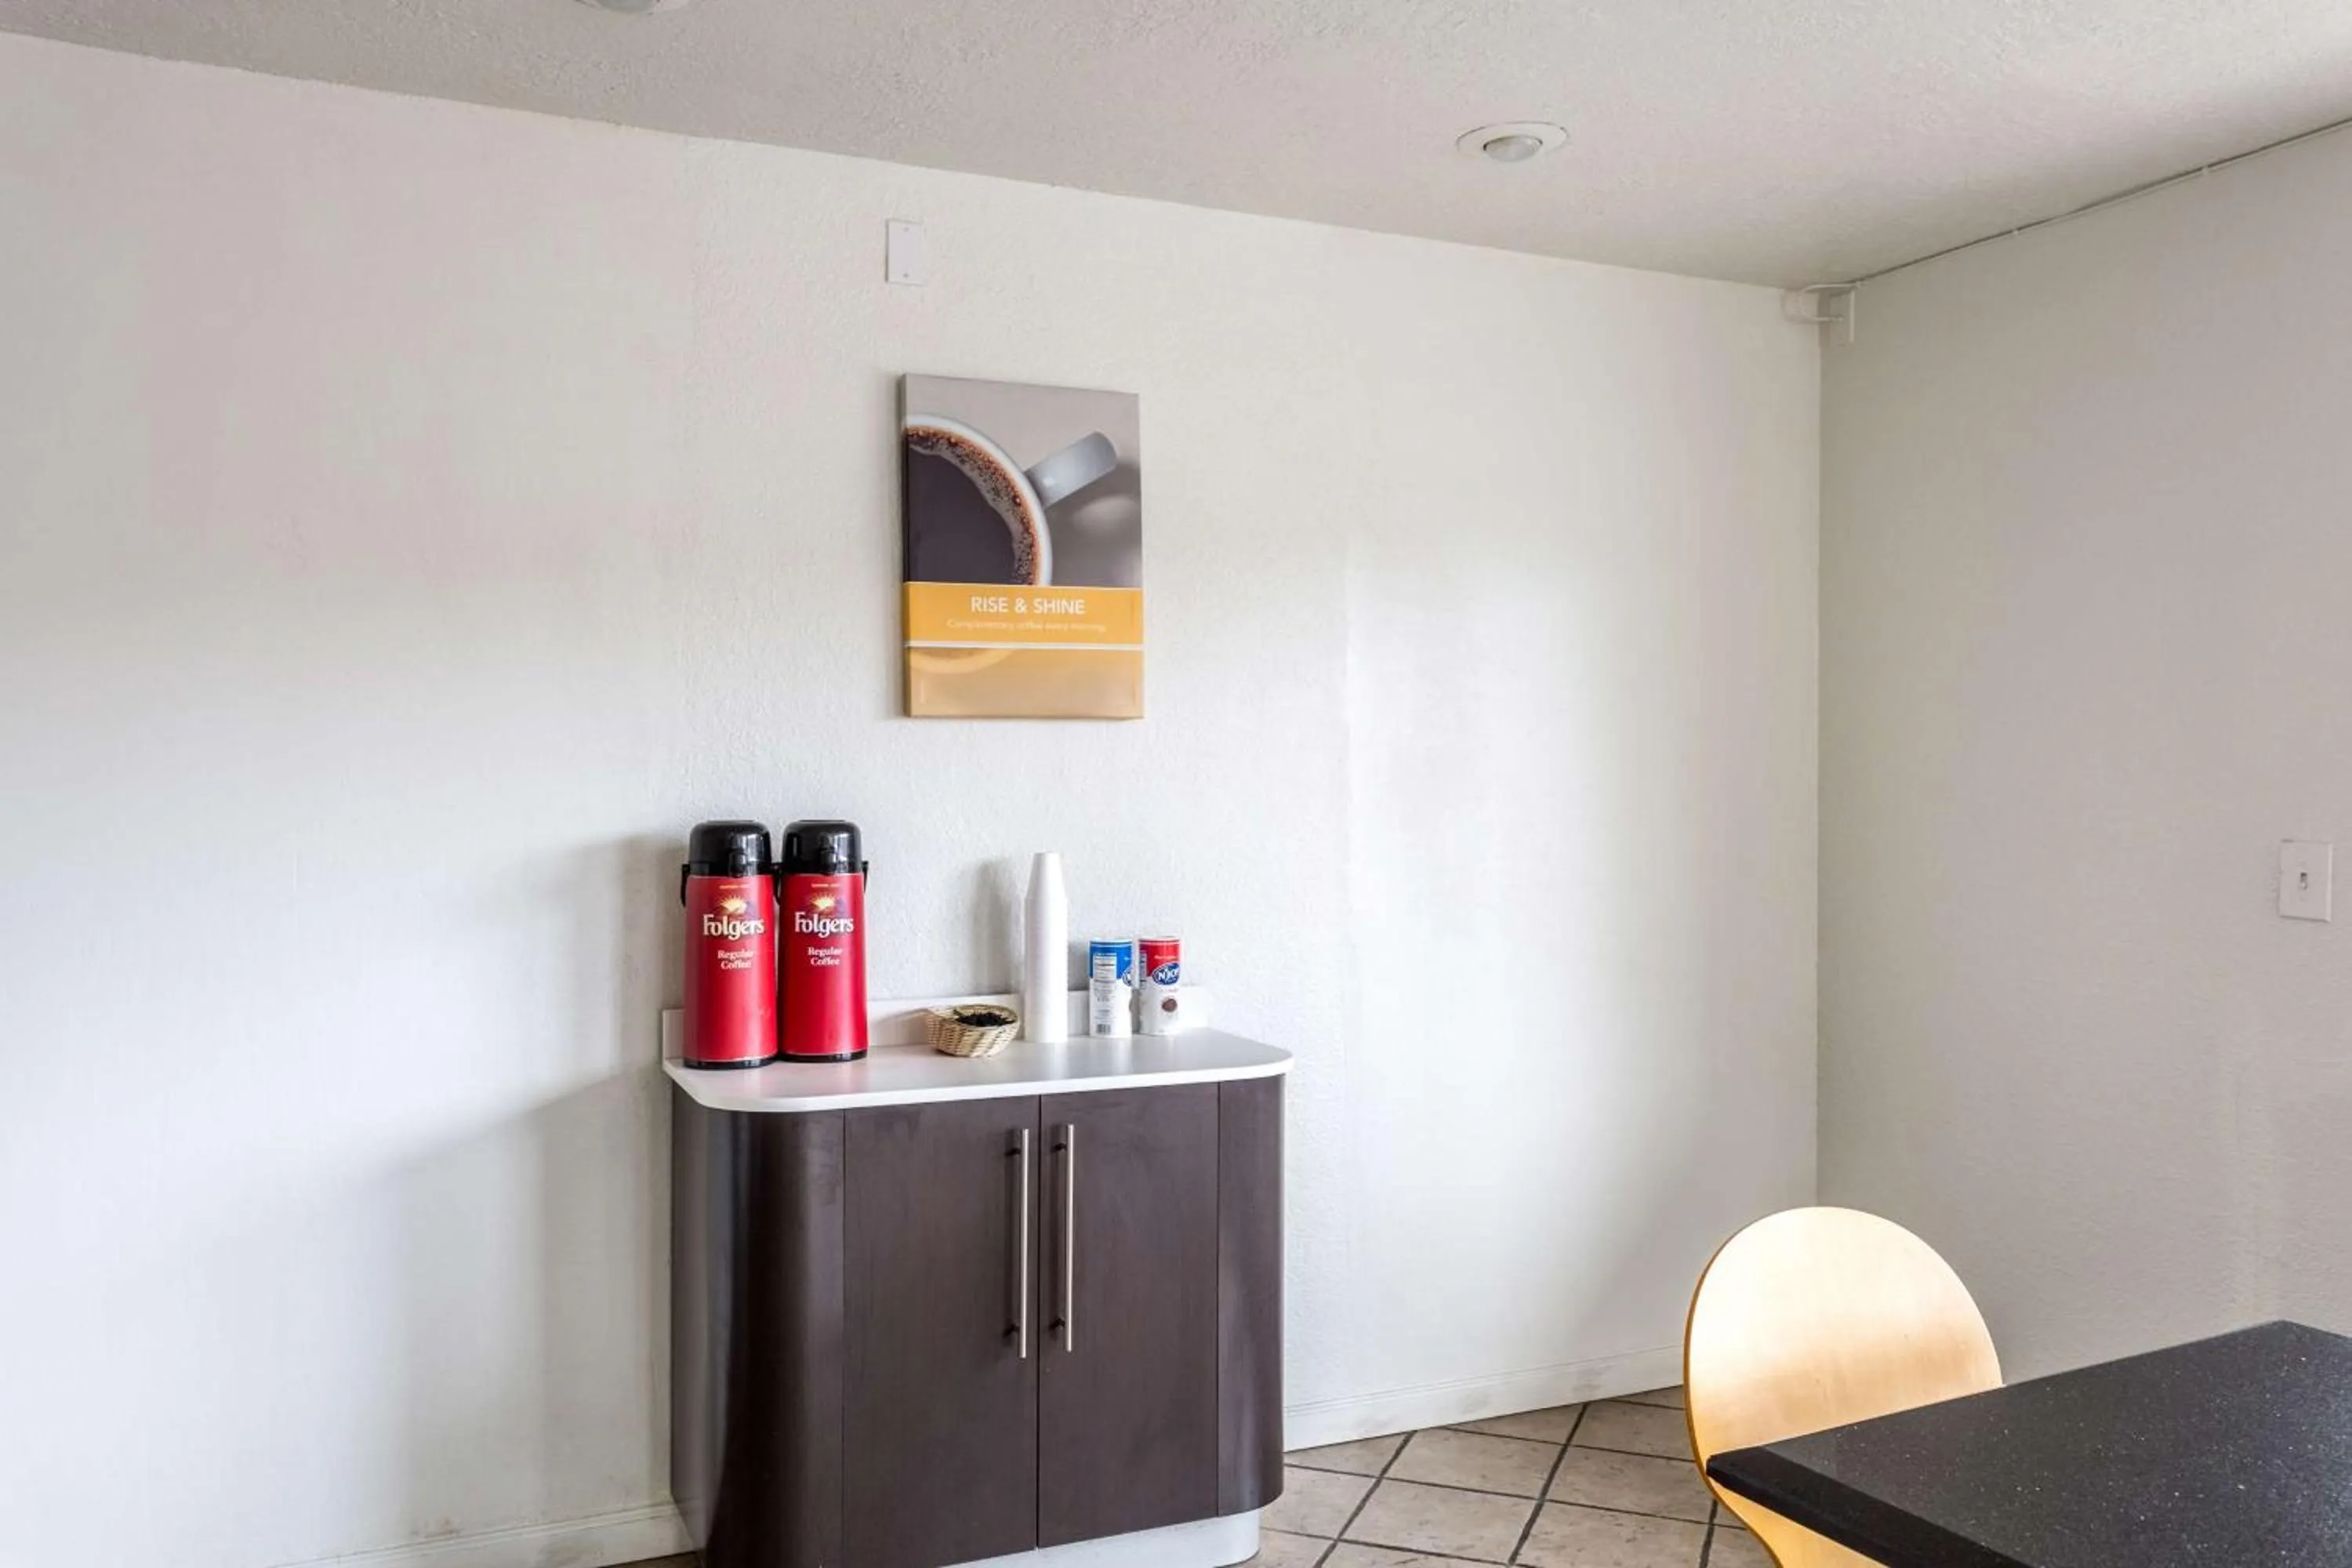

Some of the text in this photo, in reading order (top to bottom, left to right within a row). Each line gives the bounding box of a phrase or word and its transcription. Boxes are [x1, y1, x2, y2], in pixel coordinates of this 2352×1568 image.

[970, 596, 1086, 615] RISE & SHINE
[702, 913, 765, 941] Folgers
[794, 911, 855, 938] Folgers
[717, 949, 753, 960] Regular
[808, 946, 843, 957] Regular
[720, 960, 752, 970] Coffee
[810, 956, 841, 966] Coffee
